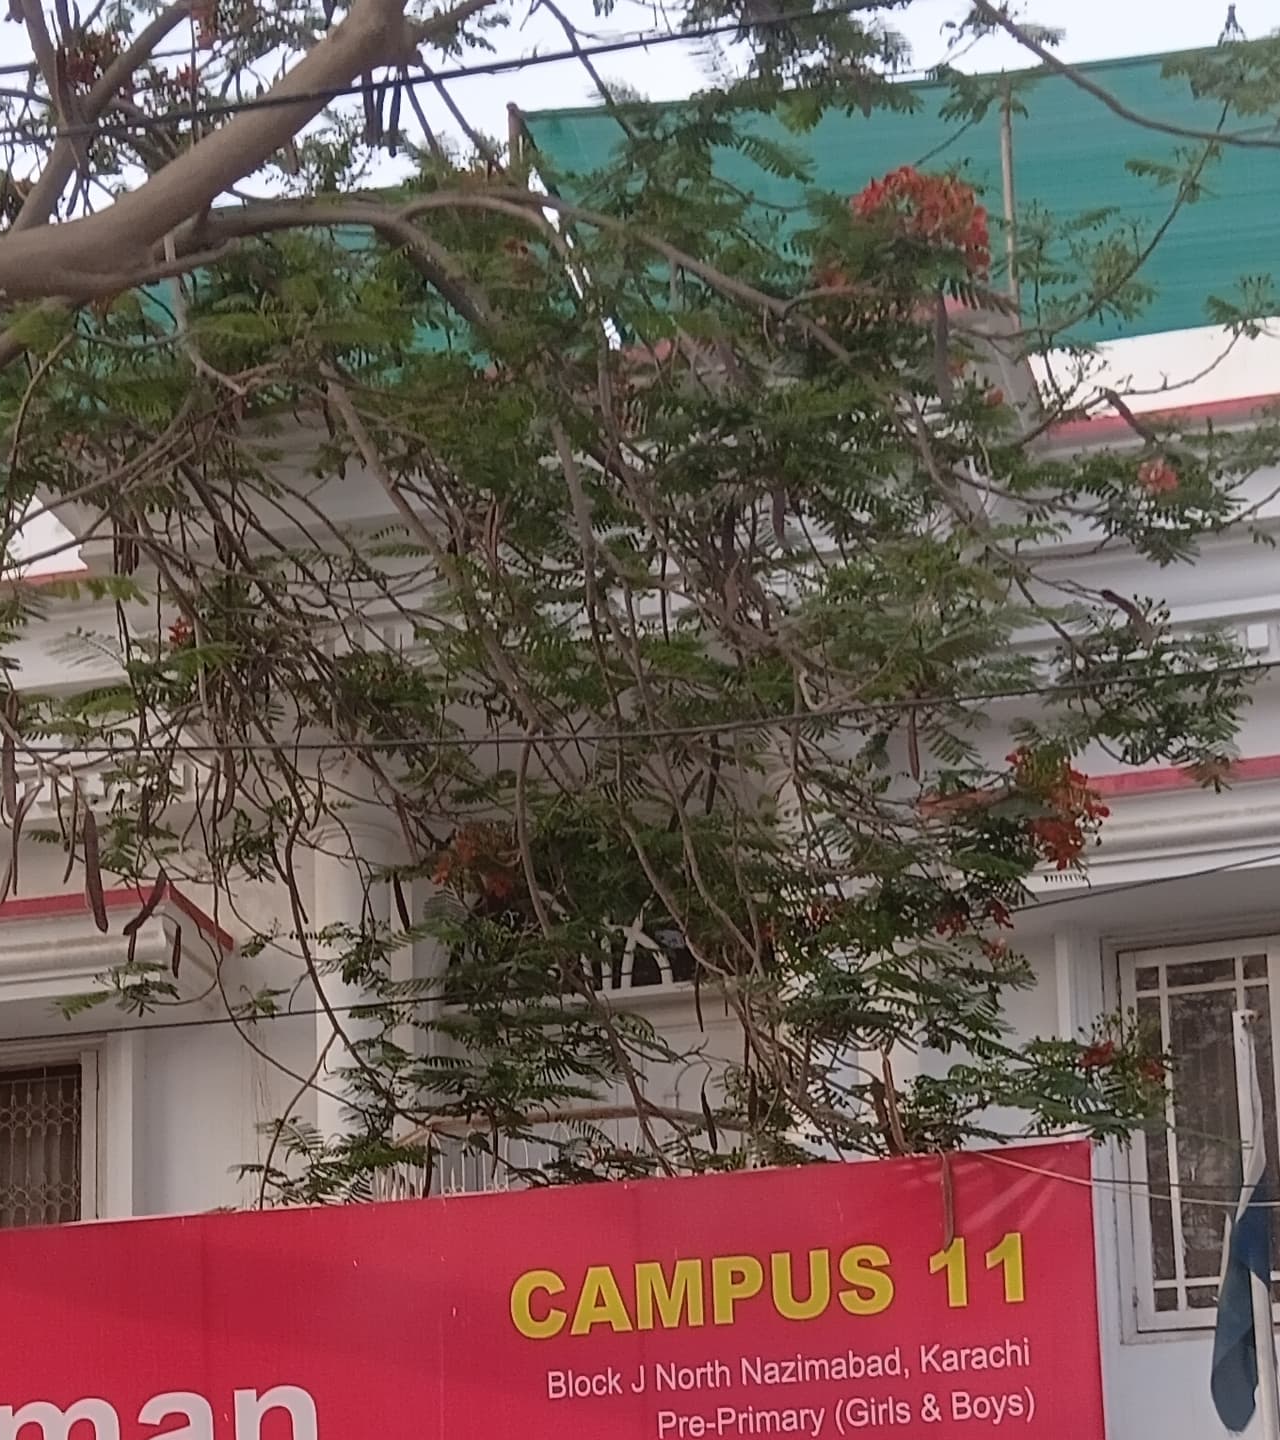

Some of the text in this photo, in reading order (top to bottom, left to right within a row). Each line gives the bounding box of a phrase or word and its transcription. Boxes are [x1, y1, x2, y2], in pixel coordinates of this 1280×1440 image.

[510, 1231, 1026, 1339] CAMPUS 11
[548, 1337, 1031, 1399] Block J North Nazimabad, Karachi
[656, 1386, 1037, 1438] Pre-Primary (Girls & Boys)
